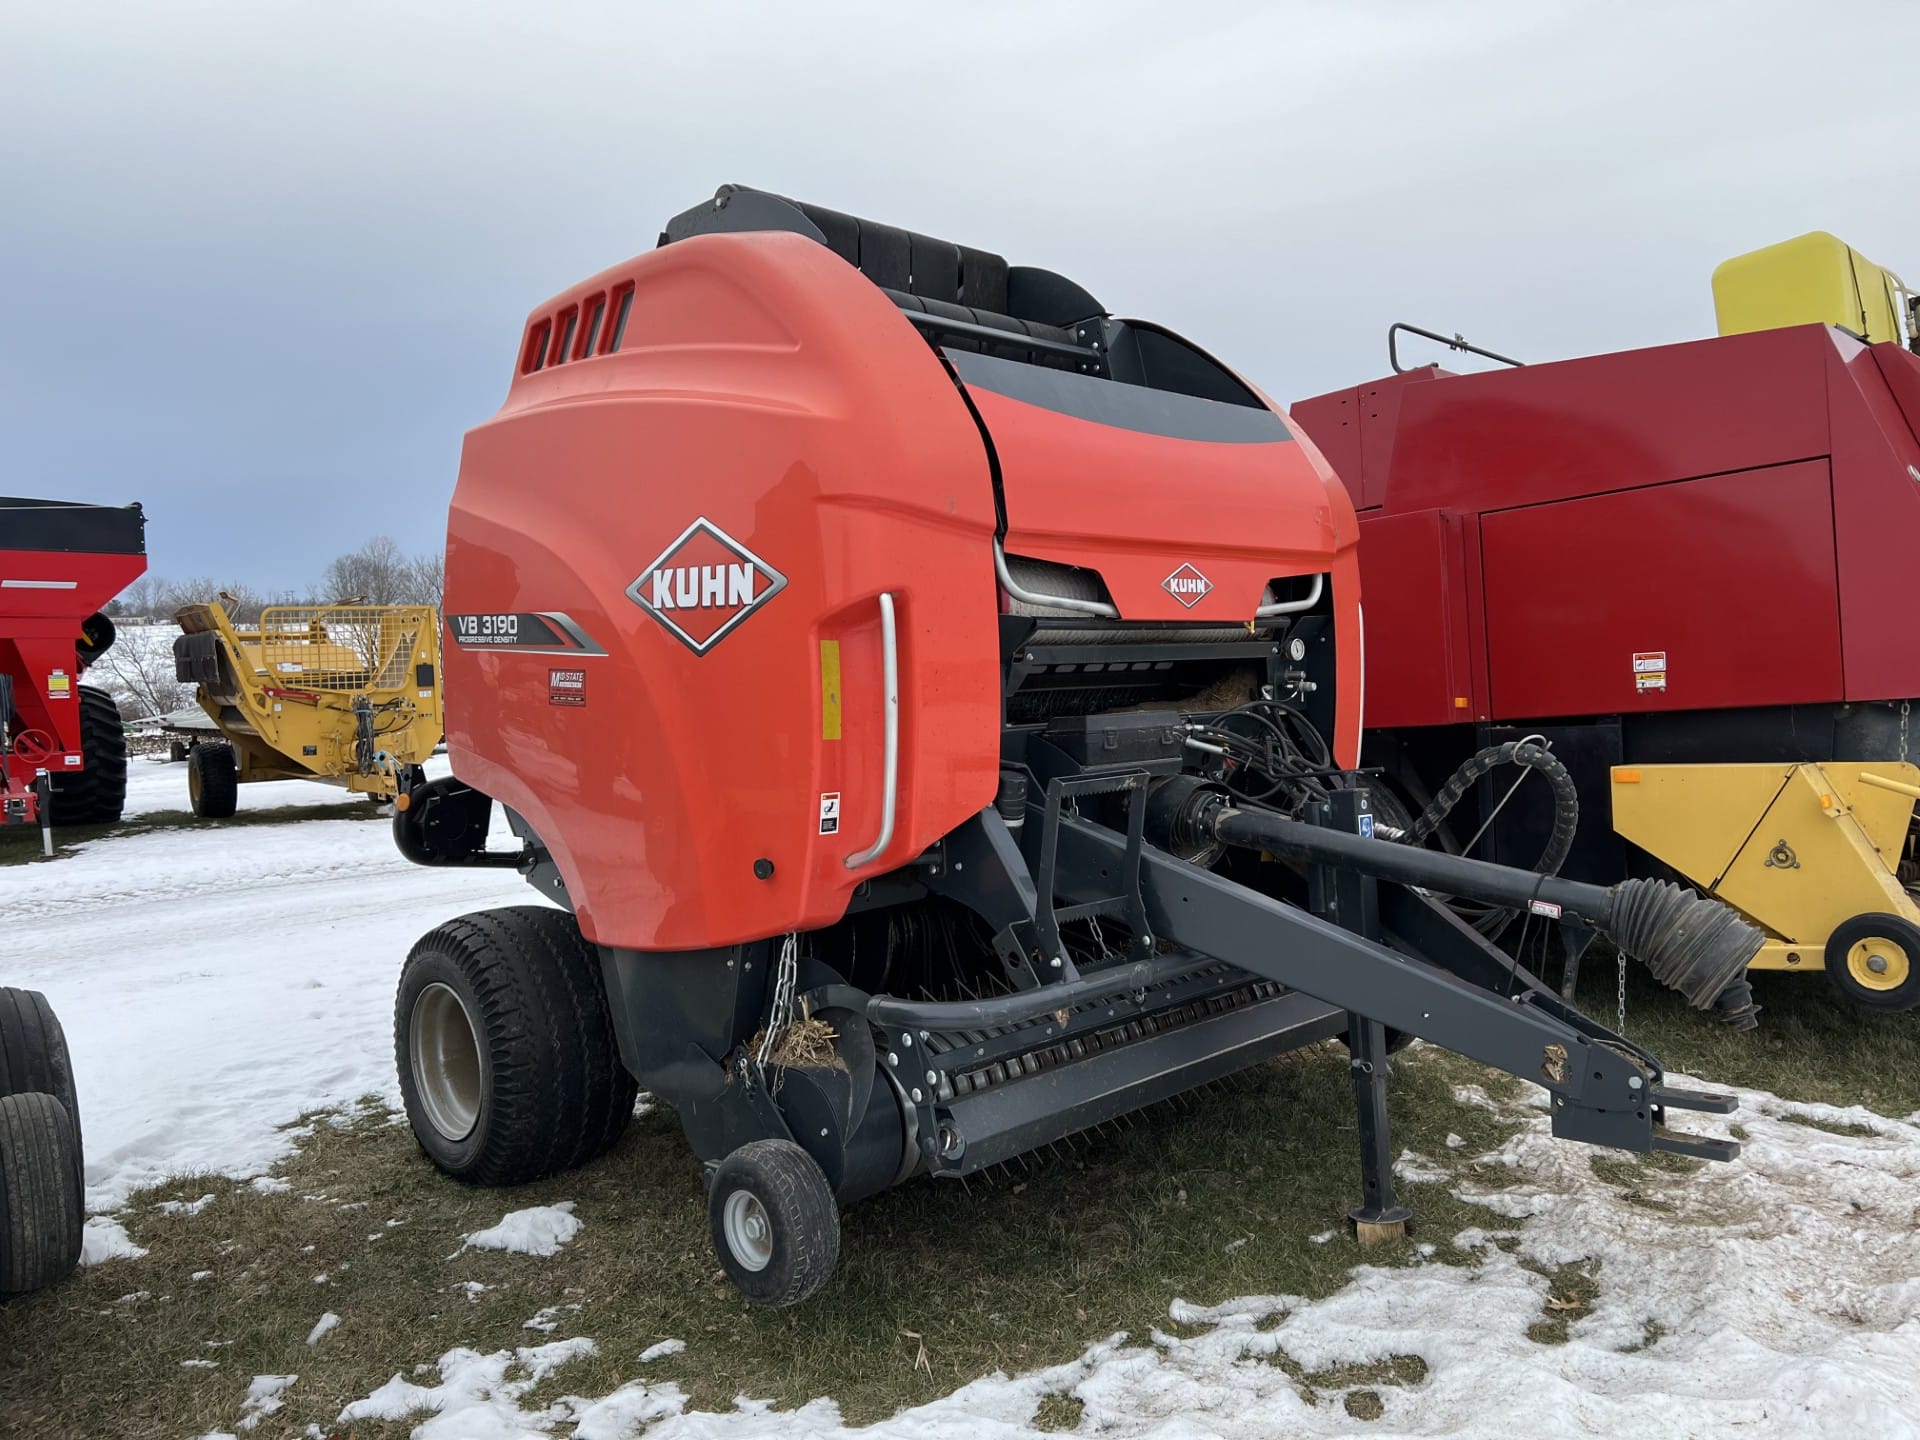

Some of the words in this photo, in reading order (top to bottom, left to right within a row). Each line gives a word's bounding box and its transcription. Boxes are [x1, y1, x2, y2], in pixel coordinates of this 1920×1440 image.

[653, 562, 754, 609] KUHN
[1170, 578, 1206, 593] KUHN
[458, 616, 478, 634] VB
[482, 615, 518, 634] 3190
[458, 635, 493, 643] PROGRESSIVE
[493, 635, 518, 643] DENSITY
